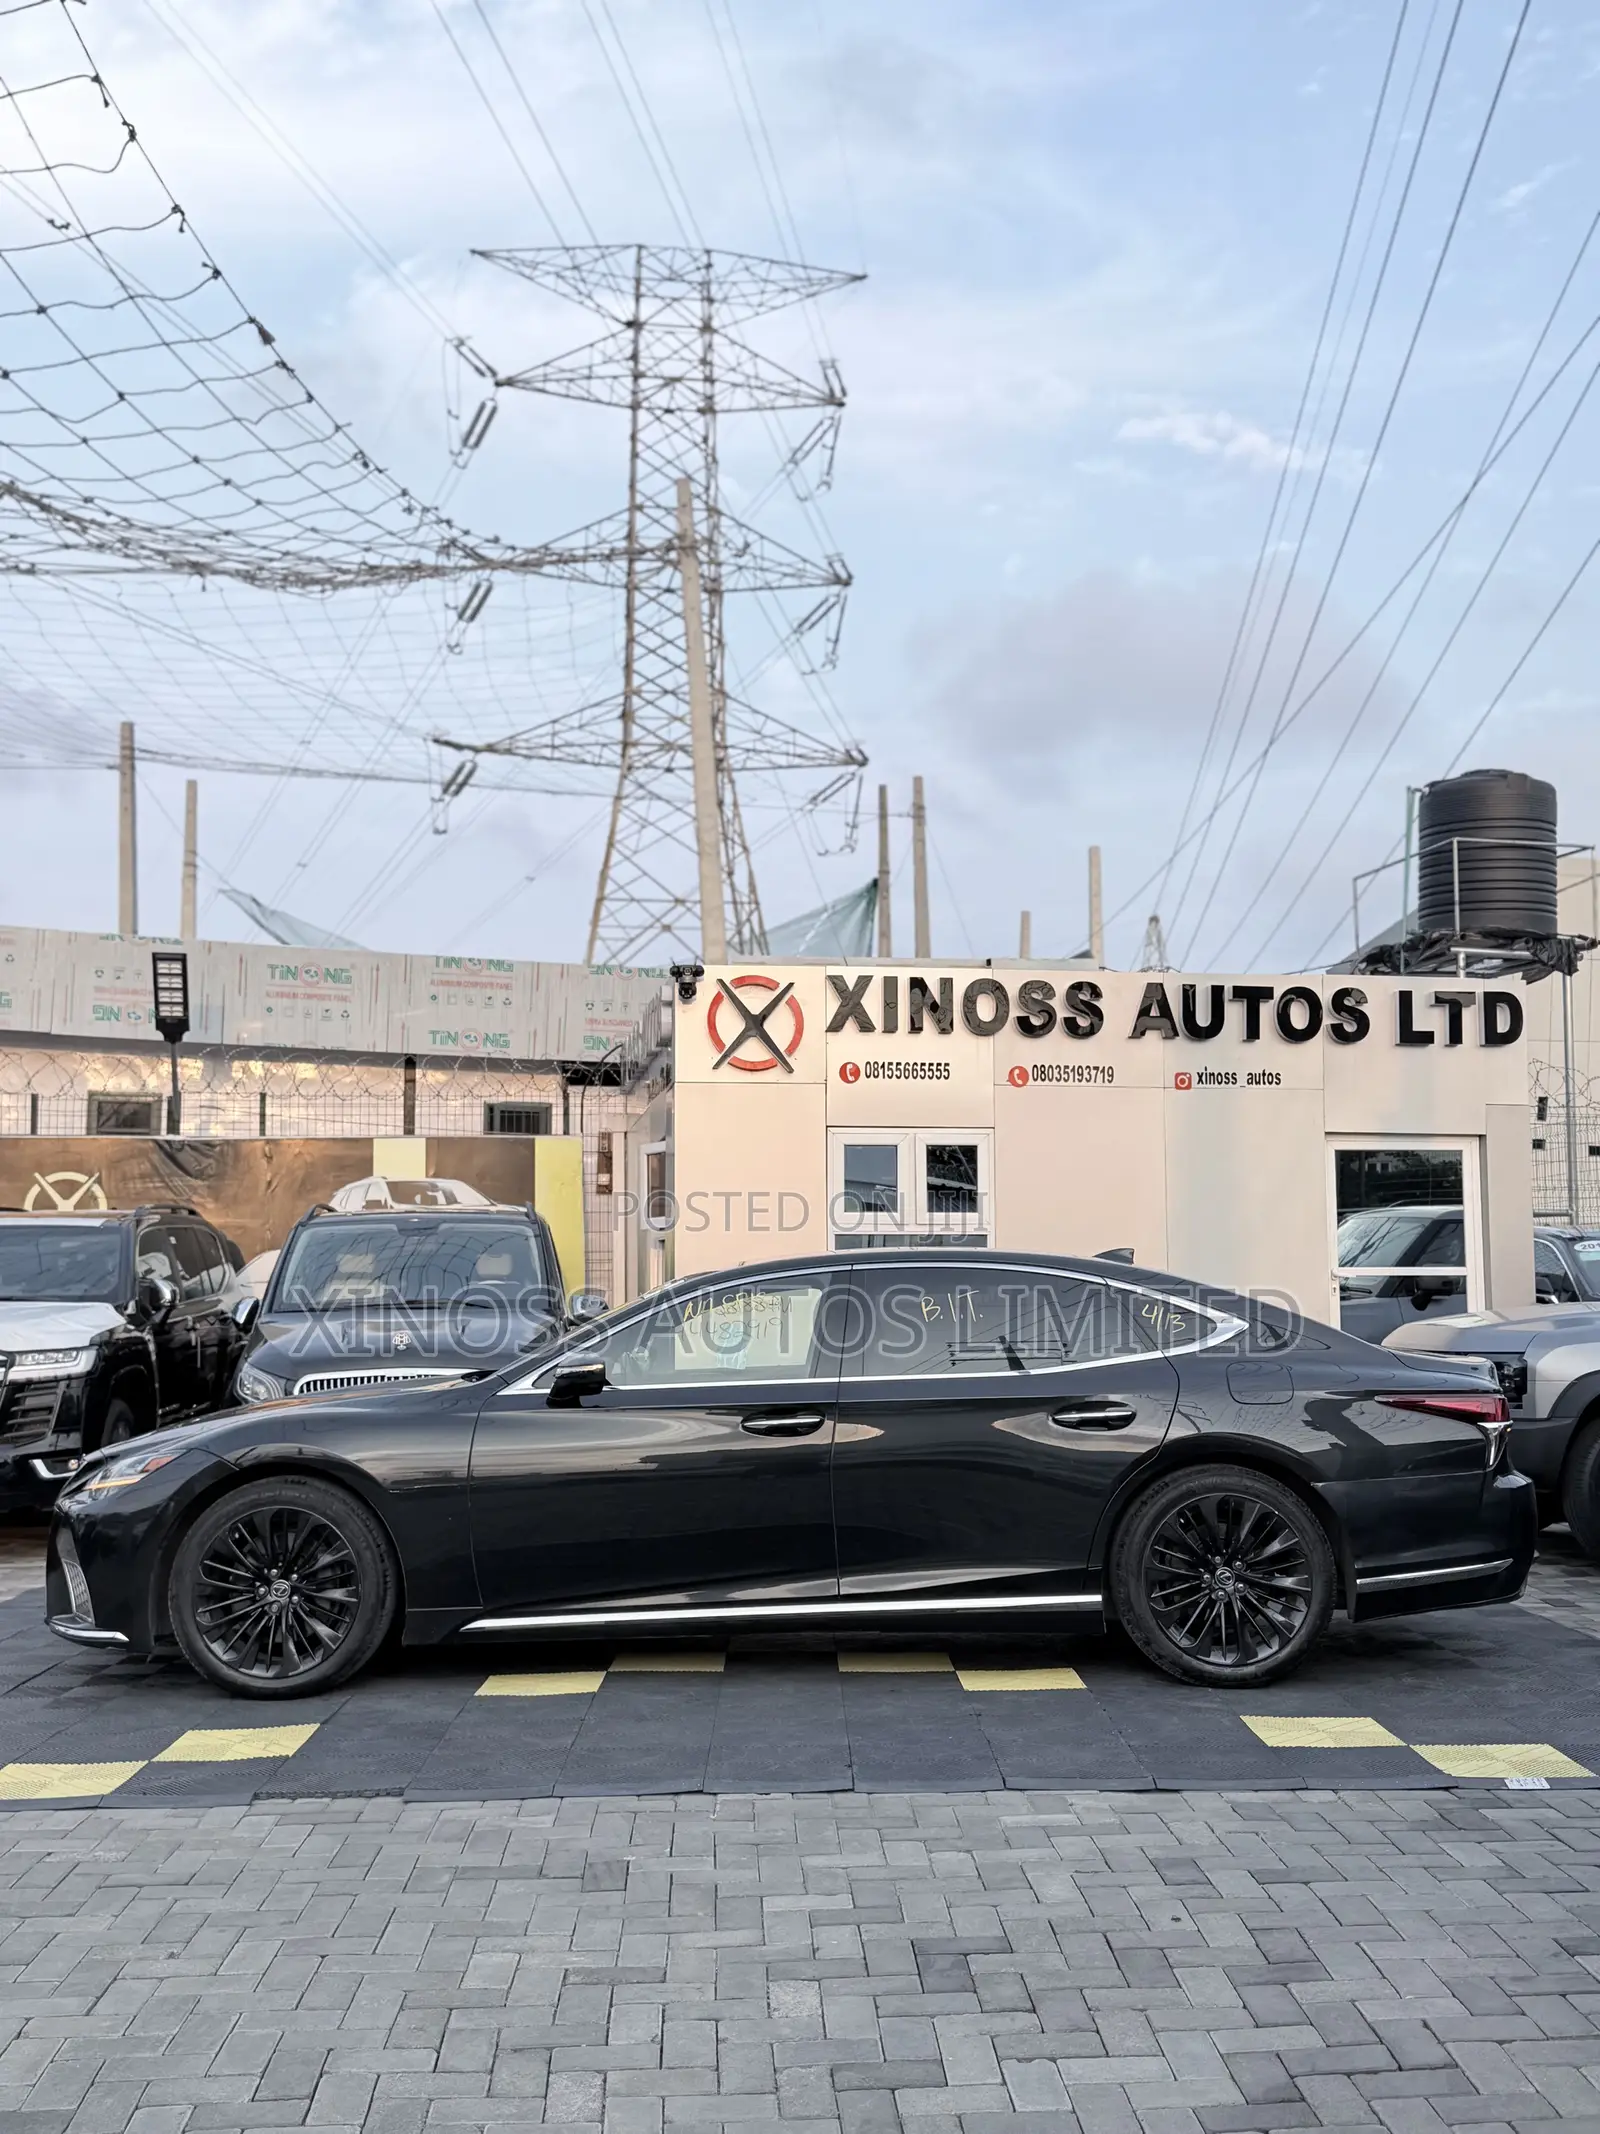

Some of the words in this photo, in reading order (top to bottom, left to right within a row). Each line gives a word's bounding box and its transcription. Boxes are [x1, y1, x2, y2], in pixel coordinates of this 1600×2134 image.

[825, 974, 1104, 1039] XINOSS
[1128, 982, 1371, 1045] AUTOS
[1394, 989, 1524, 1047] LTD
[864, 1061, 951, 1081] 08155665555
[1031, 1064, 1115, 1084] 08035193719
